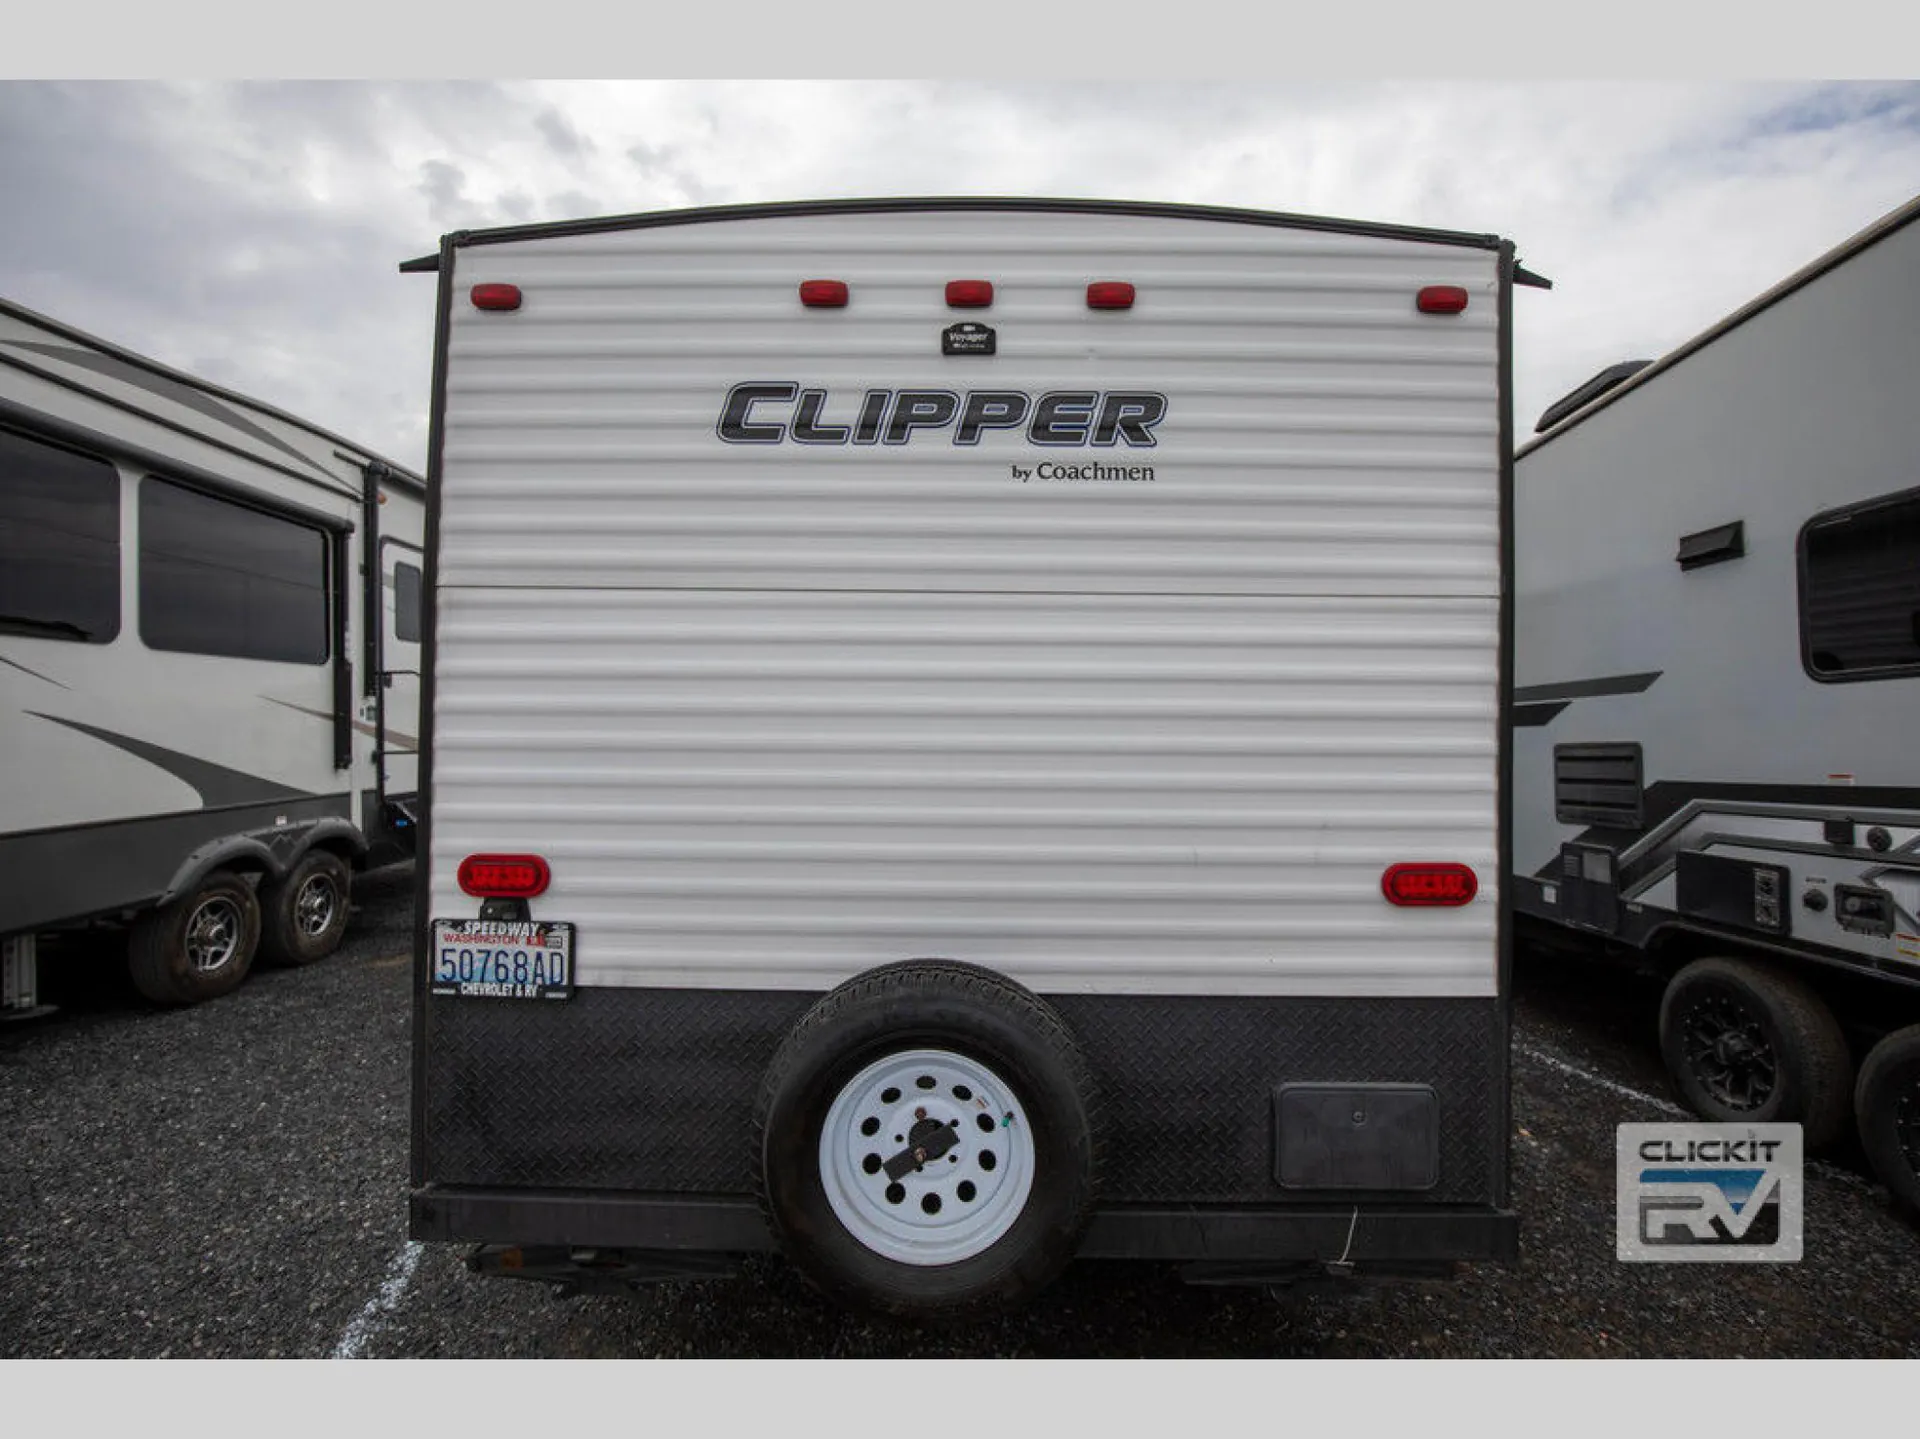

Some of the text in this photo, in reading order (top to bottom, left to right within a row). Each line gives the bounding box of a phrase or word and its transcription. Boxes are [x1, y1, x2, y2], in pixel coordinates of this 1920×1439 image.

[716, 381, 1169, 447] CLIPPER
[1012, 461, 1156, 482] by Coachmen
[463, 921, 541, 937] SPEEDWAY
[443, 933, 521, 946] WASHINGTON
[440, 948, 564, 986] 50768AD
[460, 981, 514, 996] CHEVROLET
